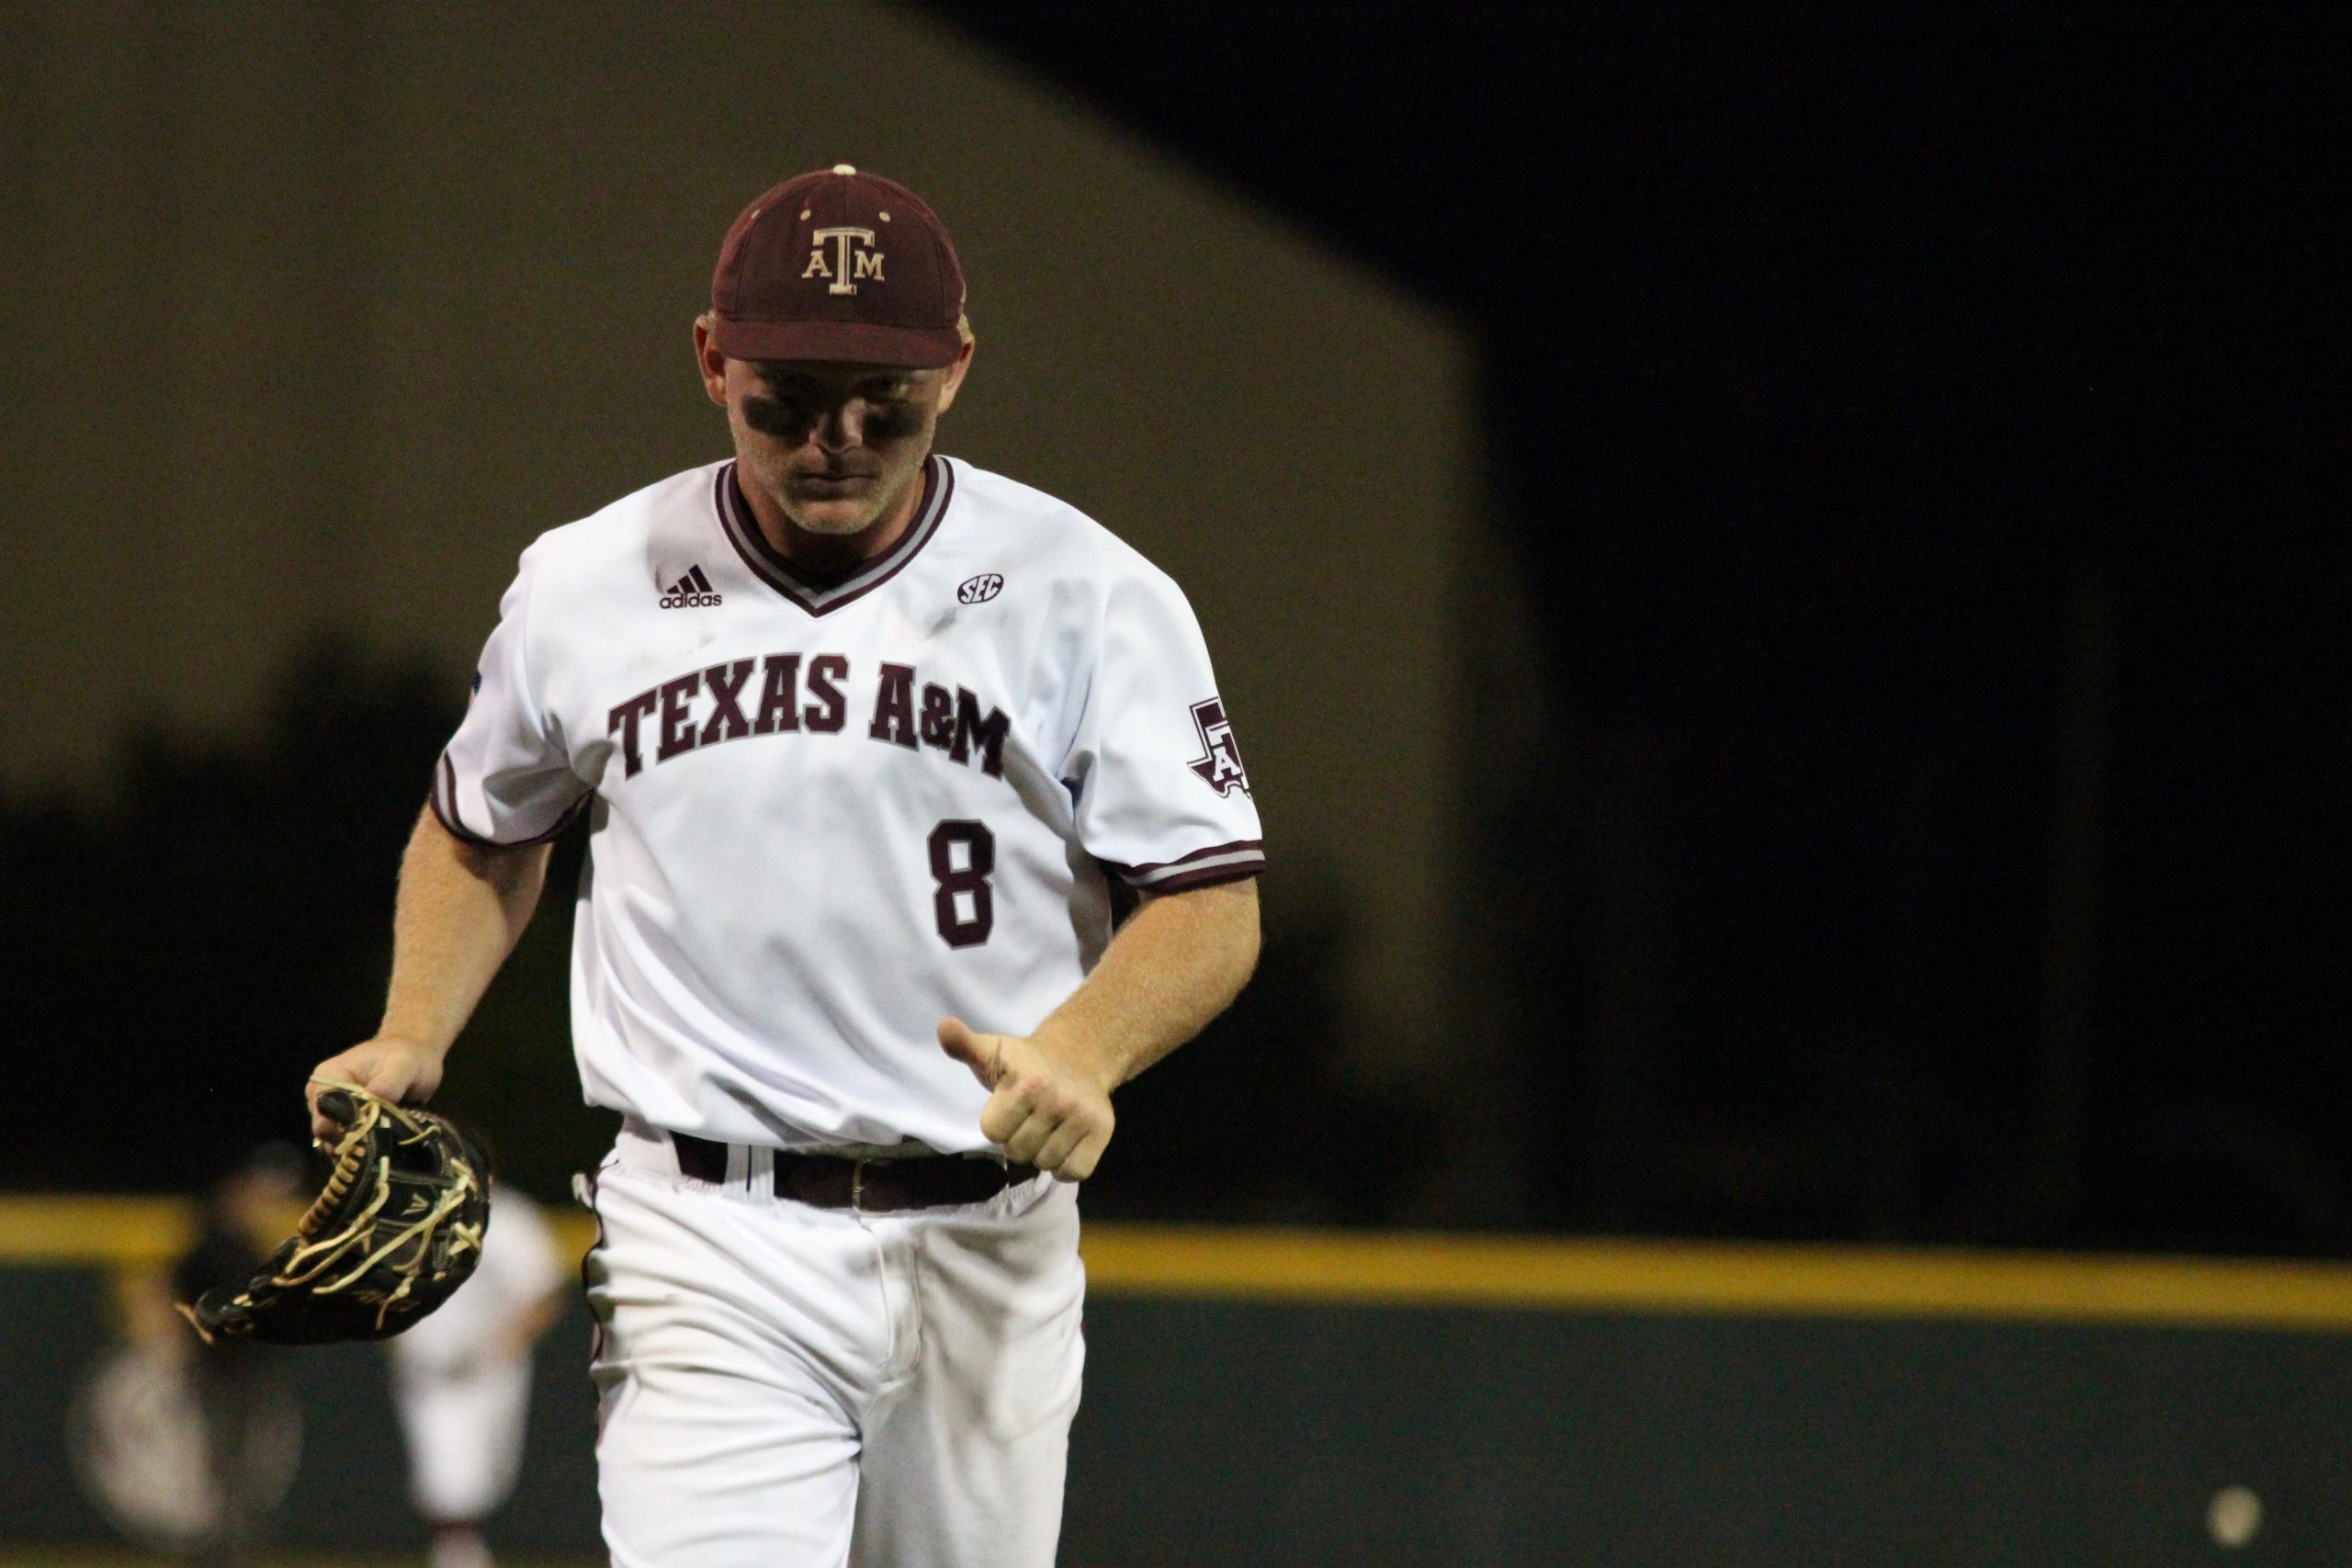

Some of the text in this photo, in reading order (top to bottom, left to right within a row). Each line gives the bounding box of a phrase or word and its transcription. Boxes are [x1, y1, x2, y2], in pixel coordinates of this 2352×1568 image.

[660, 592, 722, 609] adidas
[959, 574, 1002, 604] SEC
[608, 652, 1010, 780] TEXAS A&M
[926, 819, 995, 949] 8
